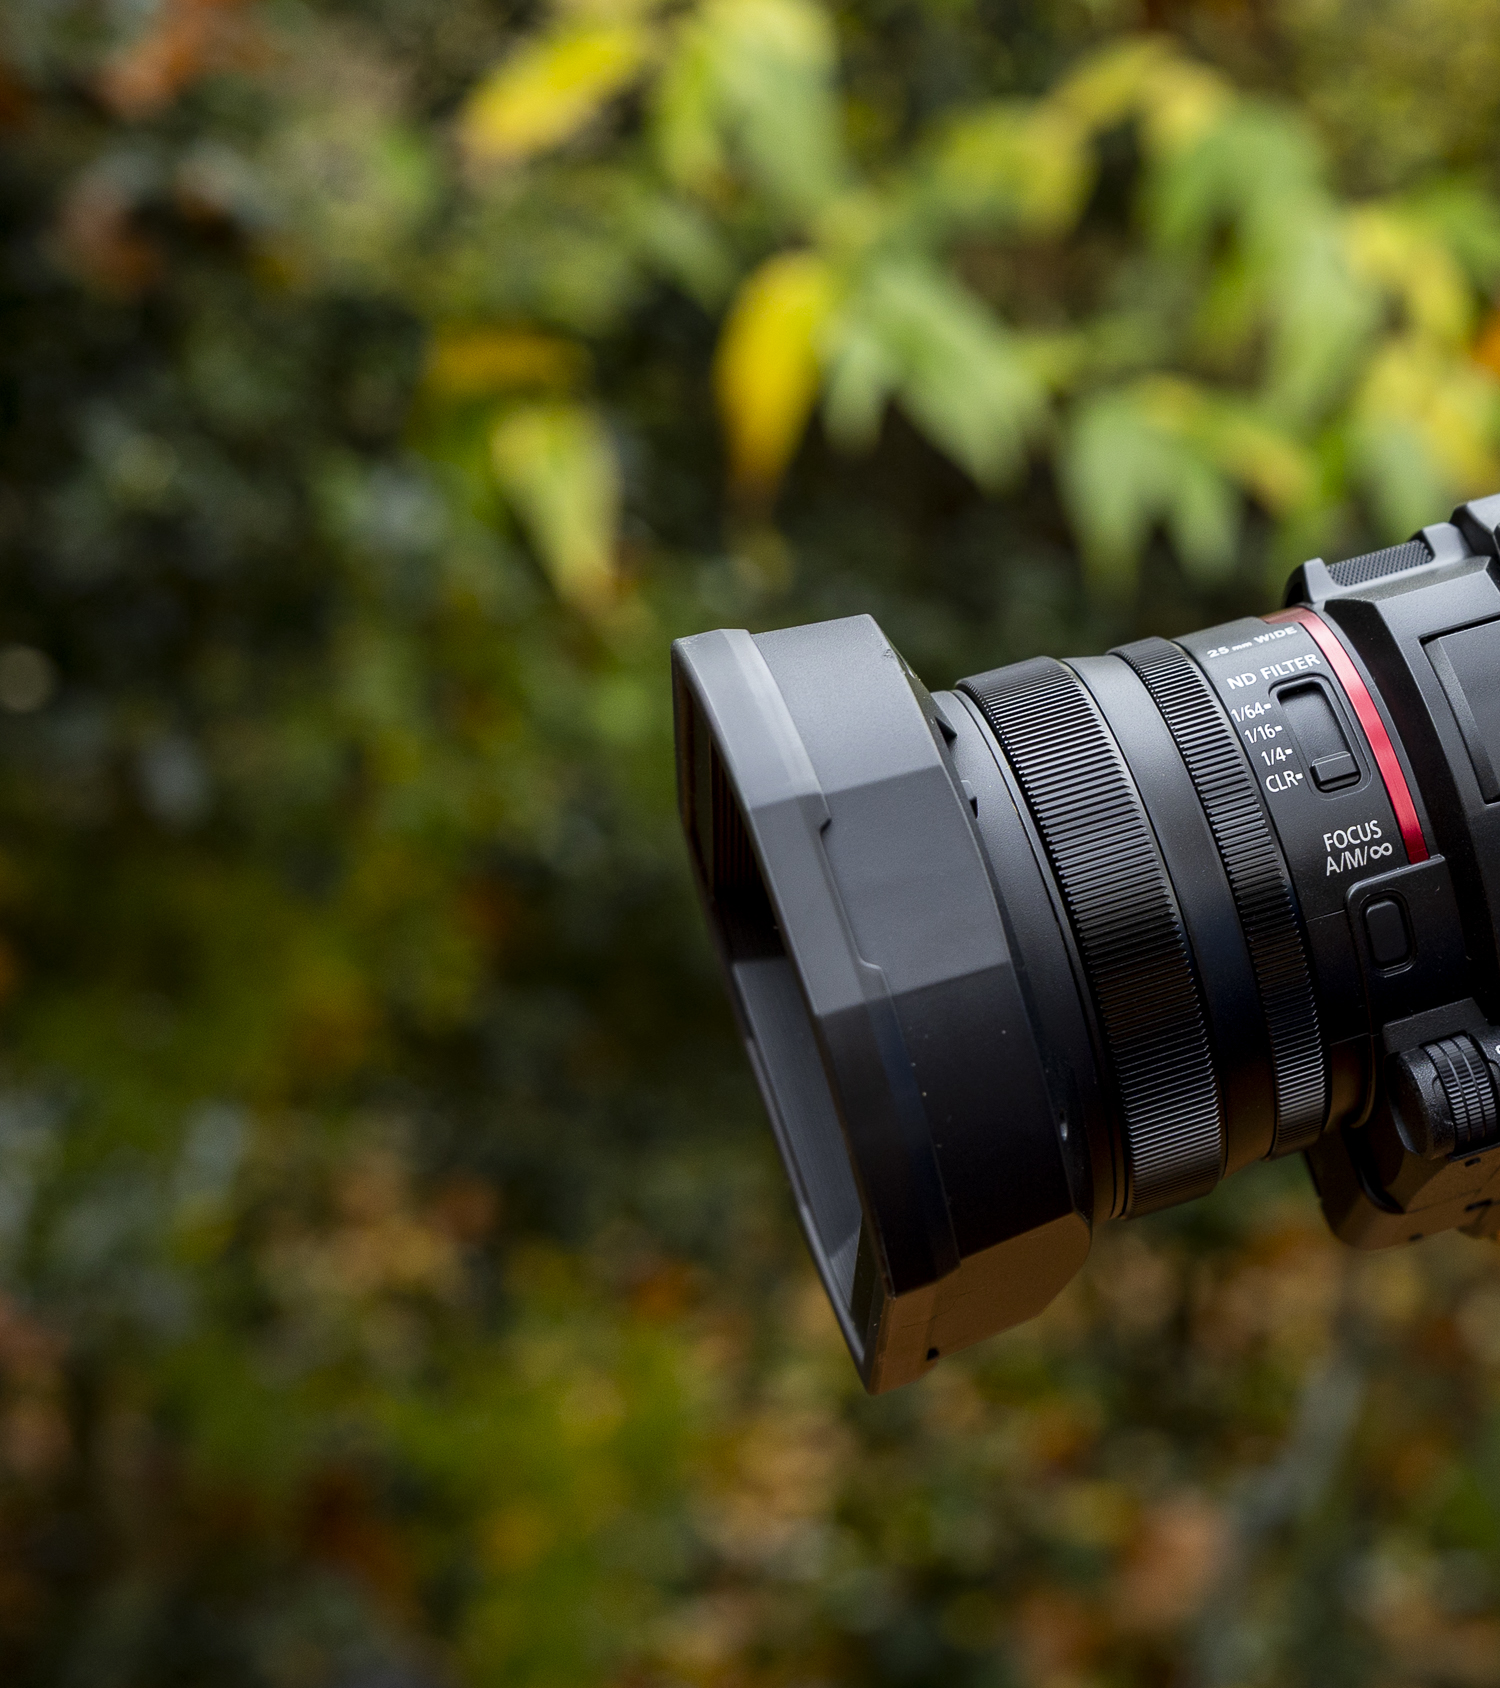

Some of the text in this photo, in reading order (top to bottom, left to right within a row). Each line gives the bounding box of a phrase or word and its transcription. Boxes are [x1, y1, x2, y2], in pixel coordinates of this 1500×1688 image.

[1206, 626, 1297, 659] 25 mm WIDE
[1226, 653, 1321, 690] ND FILTER
[1322, 819, 1382, 852] FOCUS
